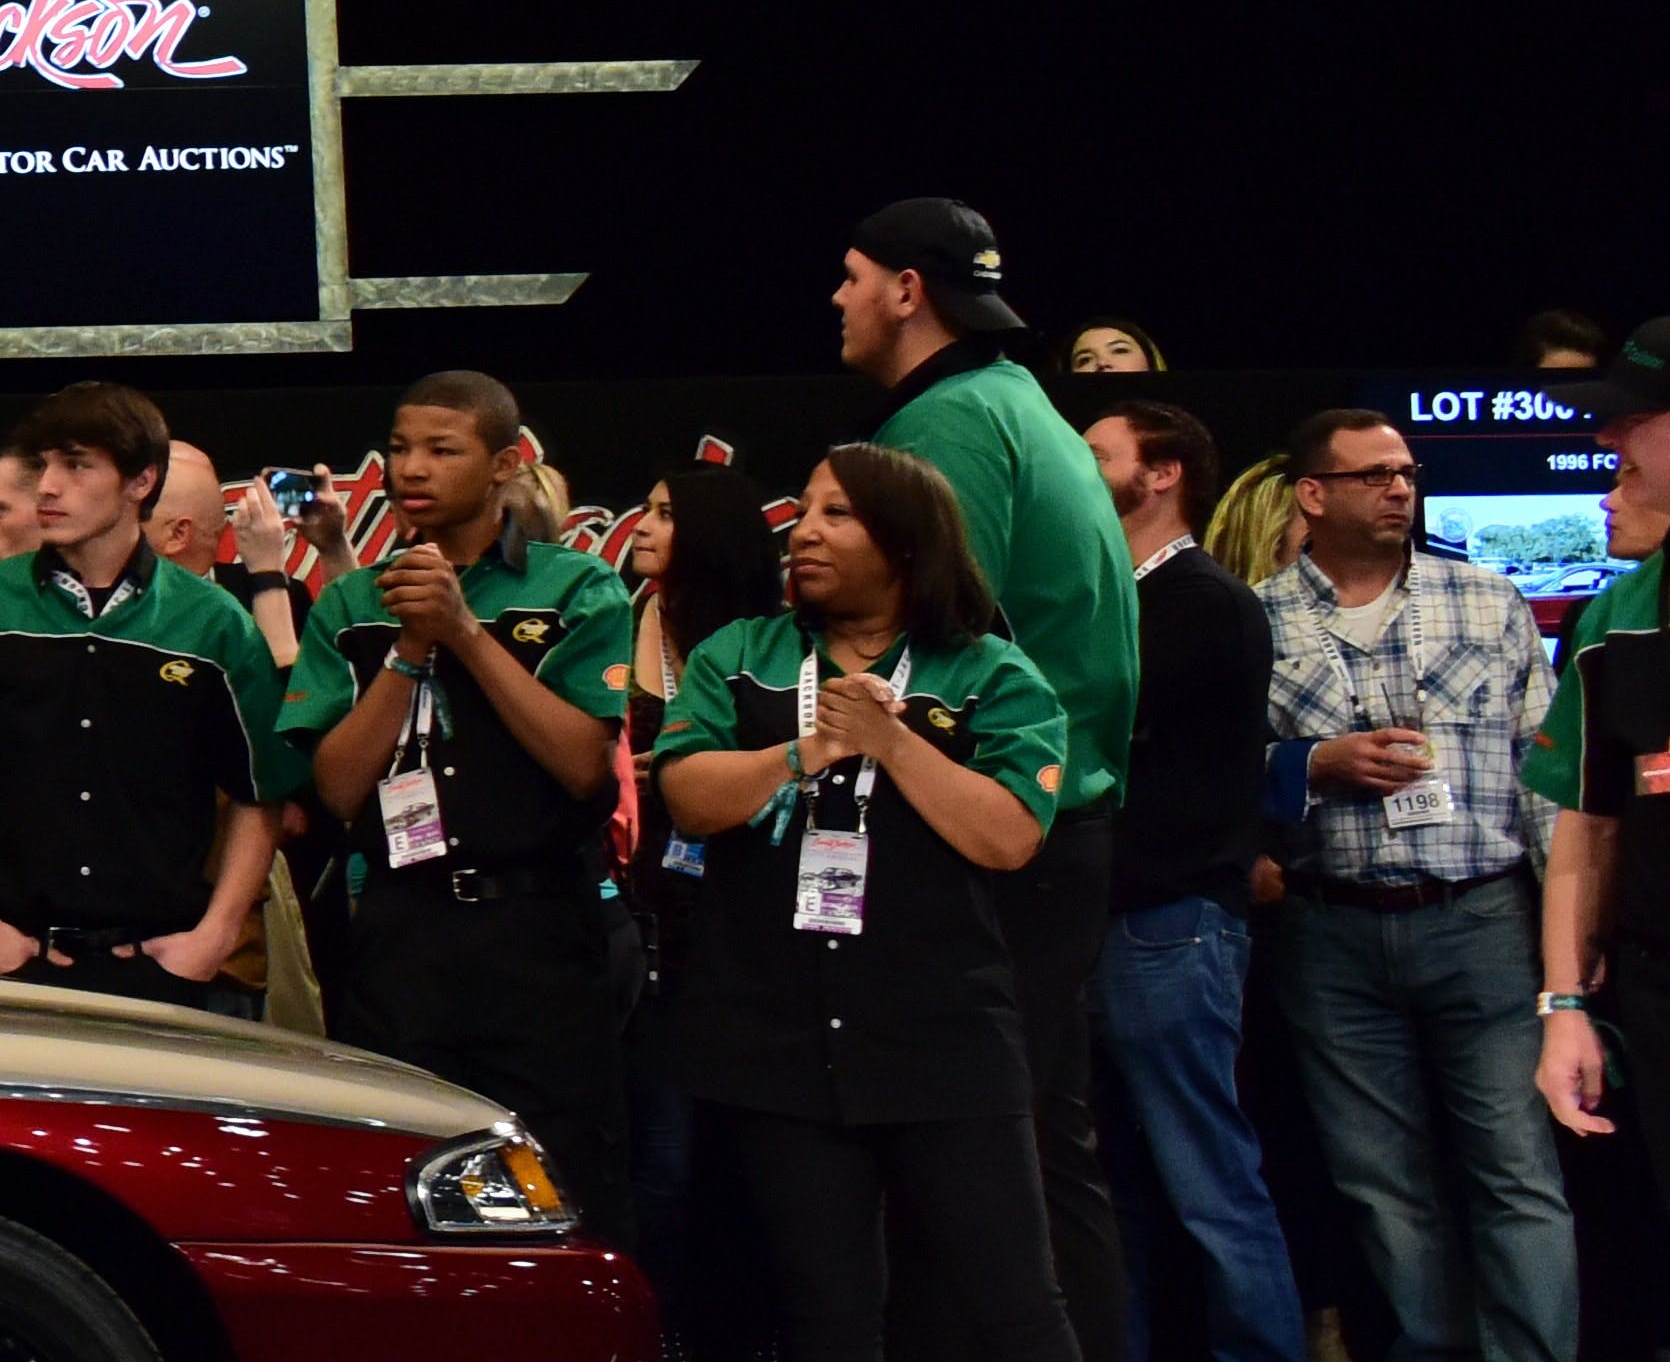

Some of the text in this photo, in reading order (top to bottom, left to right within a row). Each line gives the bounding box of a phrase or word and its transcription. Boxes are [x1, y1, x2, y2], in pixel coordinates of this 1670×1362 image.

[1411, 391, 1592, 422] LOT #30
[1546, 454, 1589, 470] 1996
[1392, 792, 1440, 814] 1198
[394, 835, 405, 851] E
